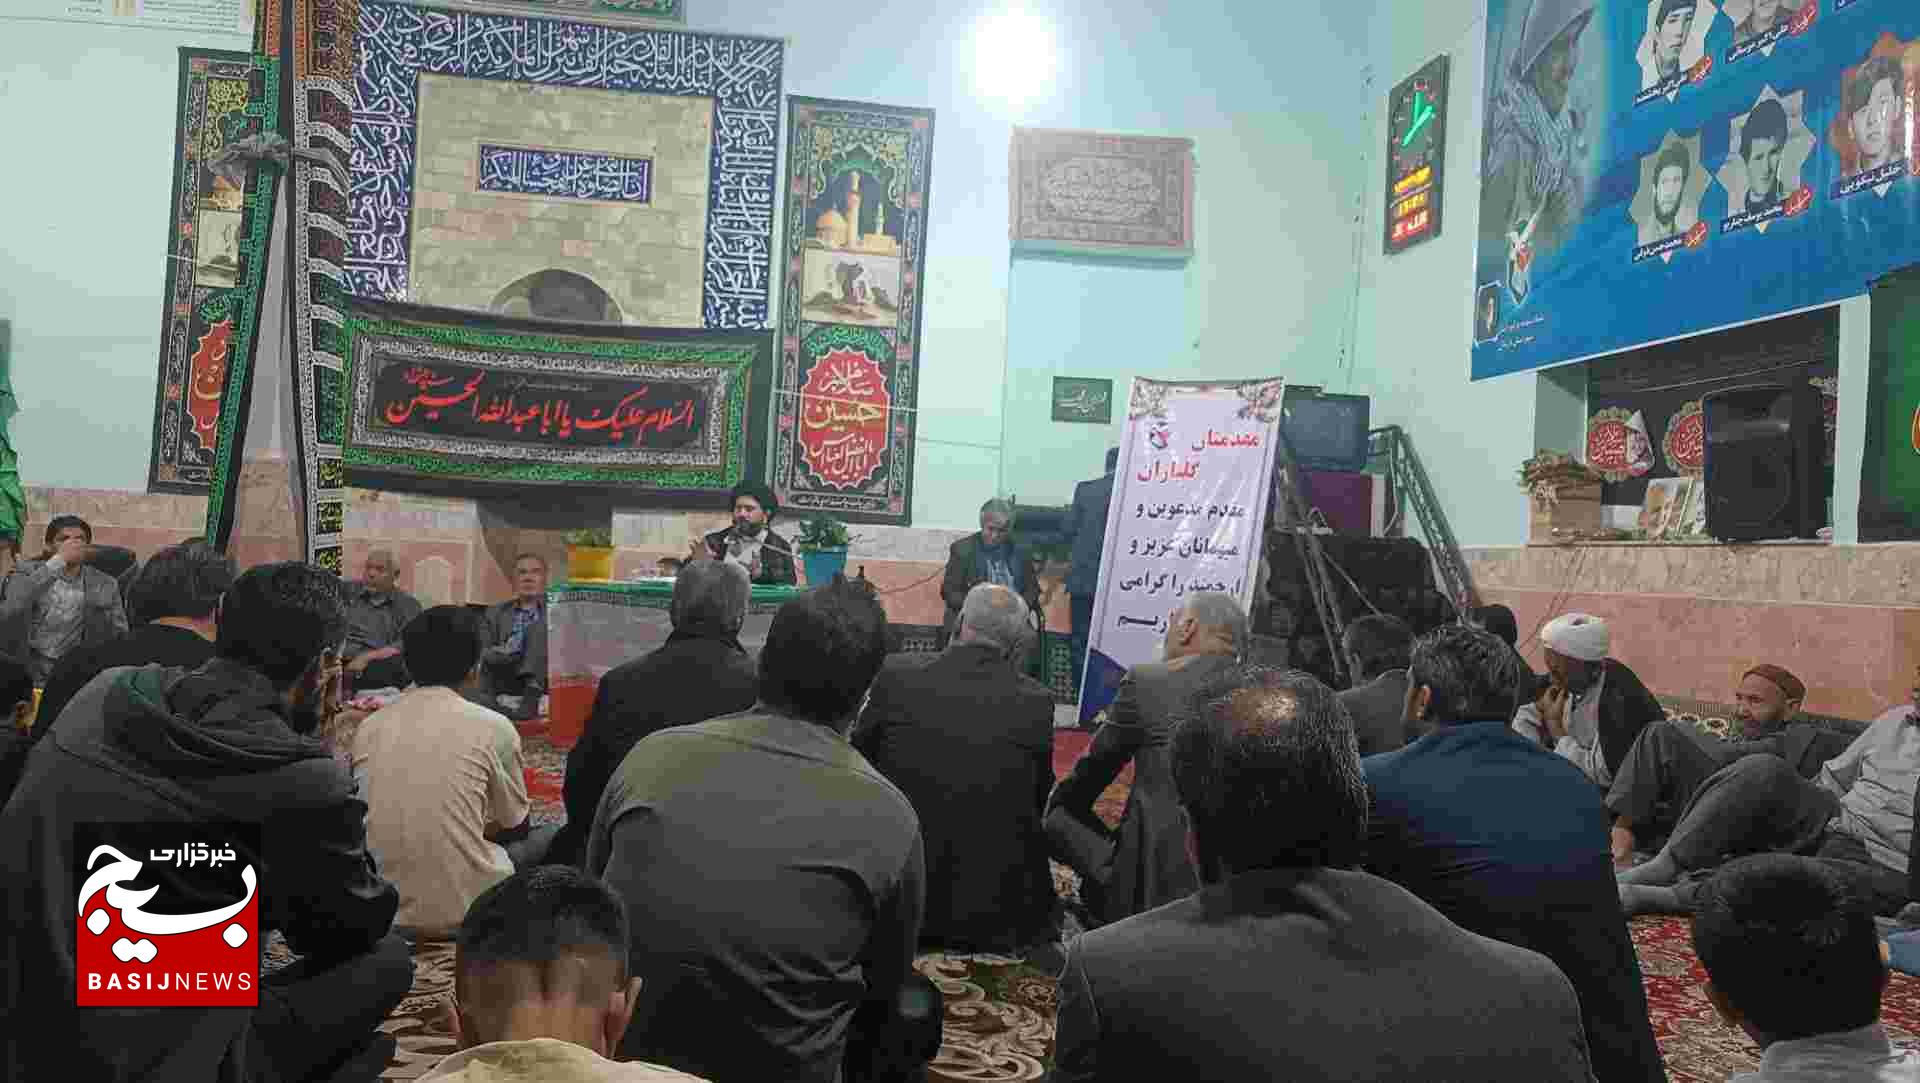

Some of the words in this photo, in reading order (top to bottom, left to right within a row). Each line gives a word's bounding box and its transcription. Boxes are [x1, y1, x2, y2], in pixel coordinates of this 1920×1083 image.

[1135, 503, 1145, 519] و
[1128, 538, 1138, 555] و
[1141, 538, 1175, 558] عزیز
[1119, 566, 1170, 595] گرامی
